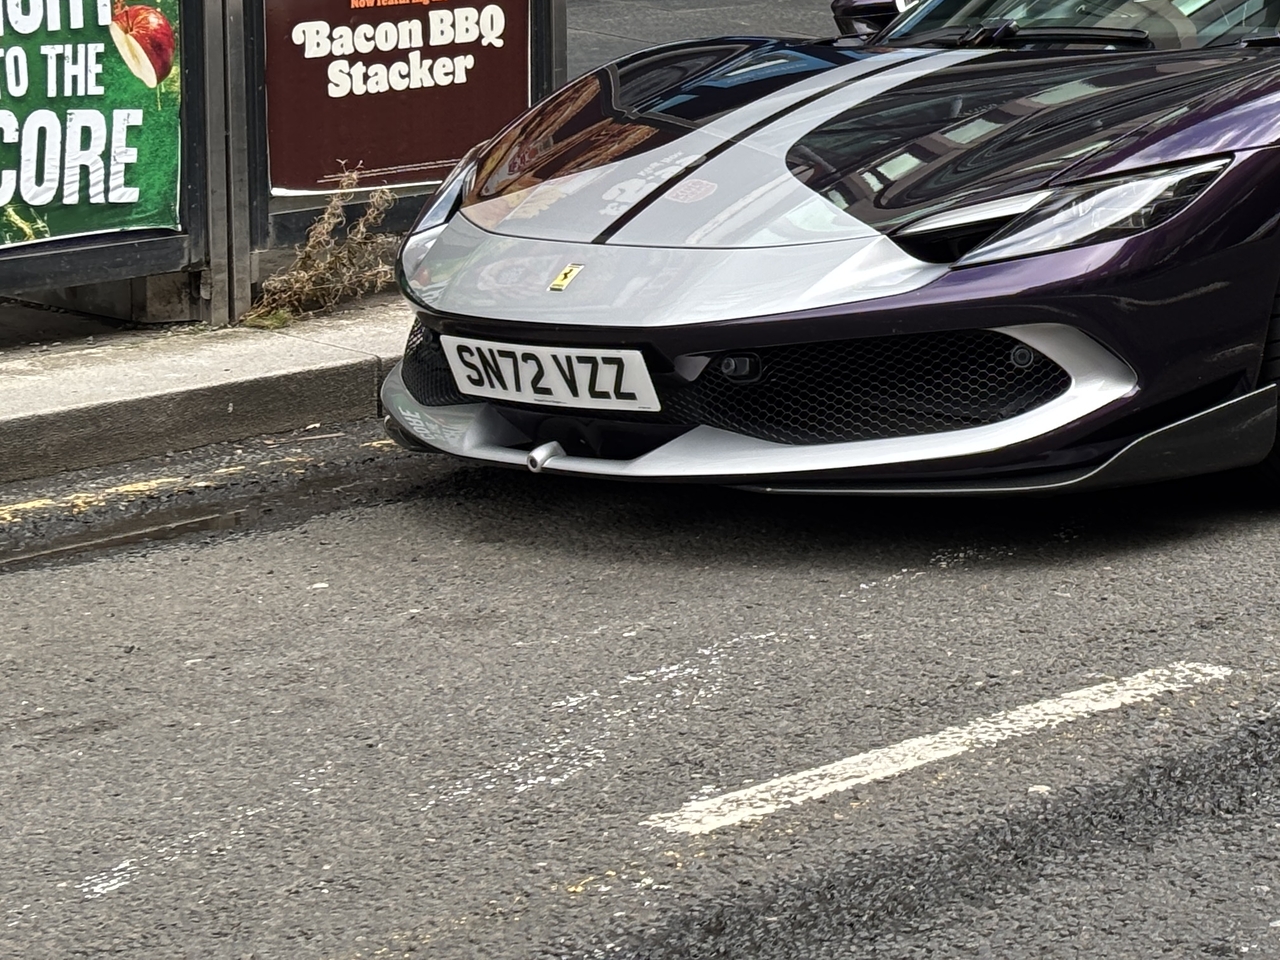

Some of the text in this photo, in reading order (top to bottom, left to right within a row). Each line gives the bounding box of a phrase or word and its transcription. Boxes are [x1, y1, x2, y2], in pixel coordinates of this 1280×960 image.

[292, 4, 505, 59] Bacon BBQ
[46, 43, 105, 97] THE
[327, 50, 475, 98] Stacker
[0, 108, 143, 207] CORE
[456, 344, 638, 401] SN72 VZZ
